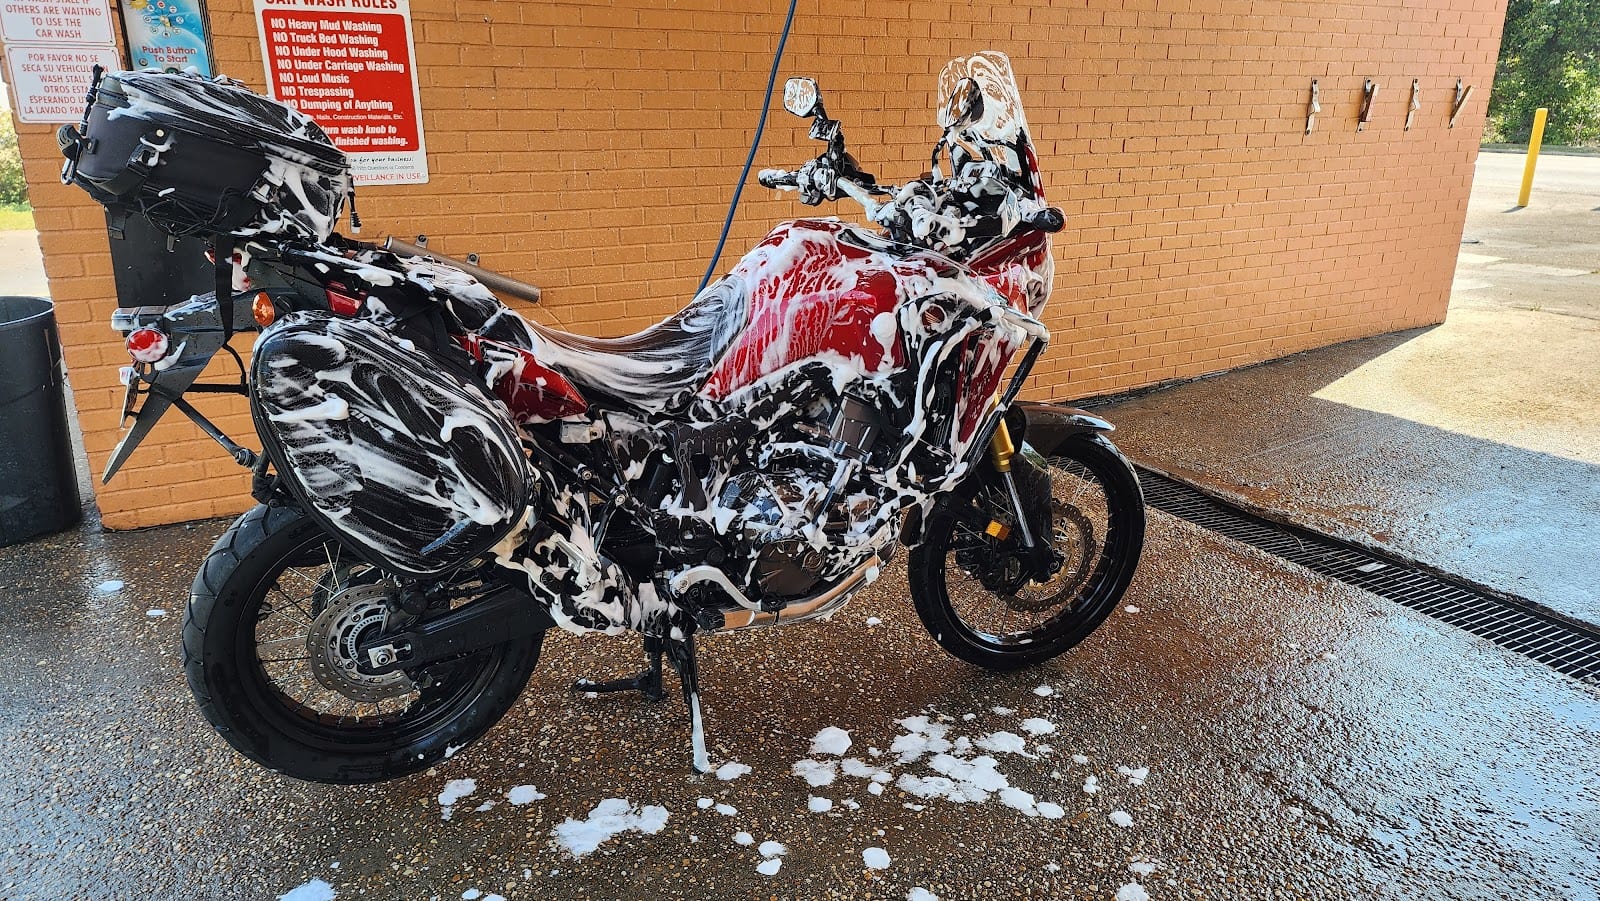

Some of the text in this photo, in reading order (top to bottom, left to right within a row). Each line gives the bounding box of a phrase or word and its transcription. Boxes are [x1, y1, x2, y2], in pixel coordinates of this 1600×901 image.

[6, 5, 101, 16] OTHERS ARE WAITING
[32, 17, 82, 27] TO USE THE
[270, 18, 383, 34] NO Heavy Mud Washing
[35, 29, 82, 39] CAR WASH
[273, 32, 379, 46] NO Truck Bed Washing
[142, 46, 196, 55] Push Button
[275, 46, 388, 60] NO Under Hood Washing
[28, 53, 99, 62] POR FAVOR NO SE
[155, 54, 188, 63] To Start
[22, 64, 41, 72] SECA
[44, 64, 54, 72] SU
[56, 64, 92, 73] VEHICUL
[277, 59, 404, 73] NO Under Carriage Washing
[39, 75, 62, 83] WASH
[65, 76, 87, 84] STALL
[279, 73, 350, 83] NO Loud Music
[44, 86, 70, 94] OTROS
[281, 86, 354, 98] NO Trespassing
[29, 96, 76, 104] ESPERANDO
[300, 99, 342, 111] Dumping
[343, 99, 353, 110] of
[355, 99, 393, 111] Anything
[24, 106, 84, 114] LA LAVADO PAR
[341, 125, 364, 134] wash
[365, 125, 386, 133] knob
[388, 125, 397, 133] to
[335, 136, 408, 146] finished washing.
[407, 172, 421, 180] USE
